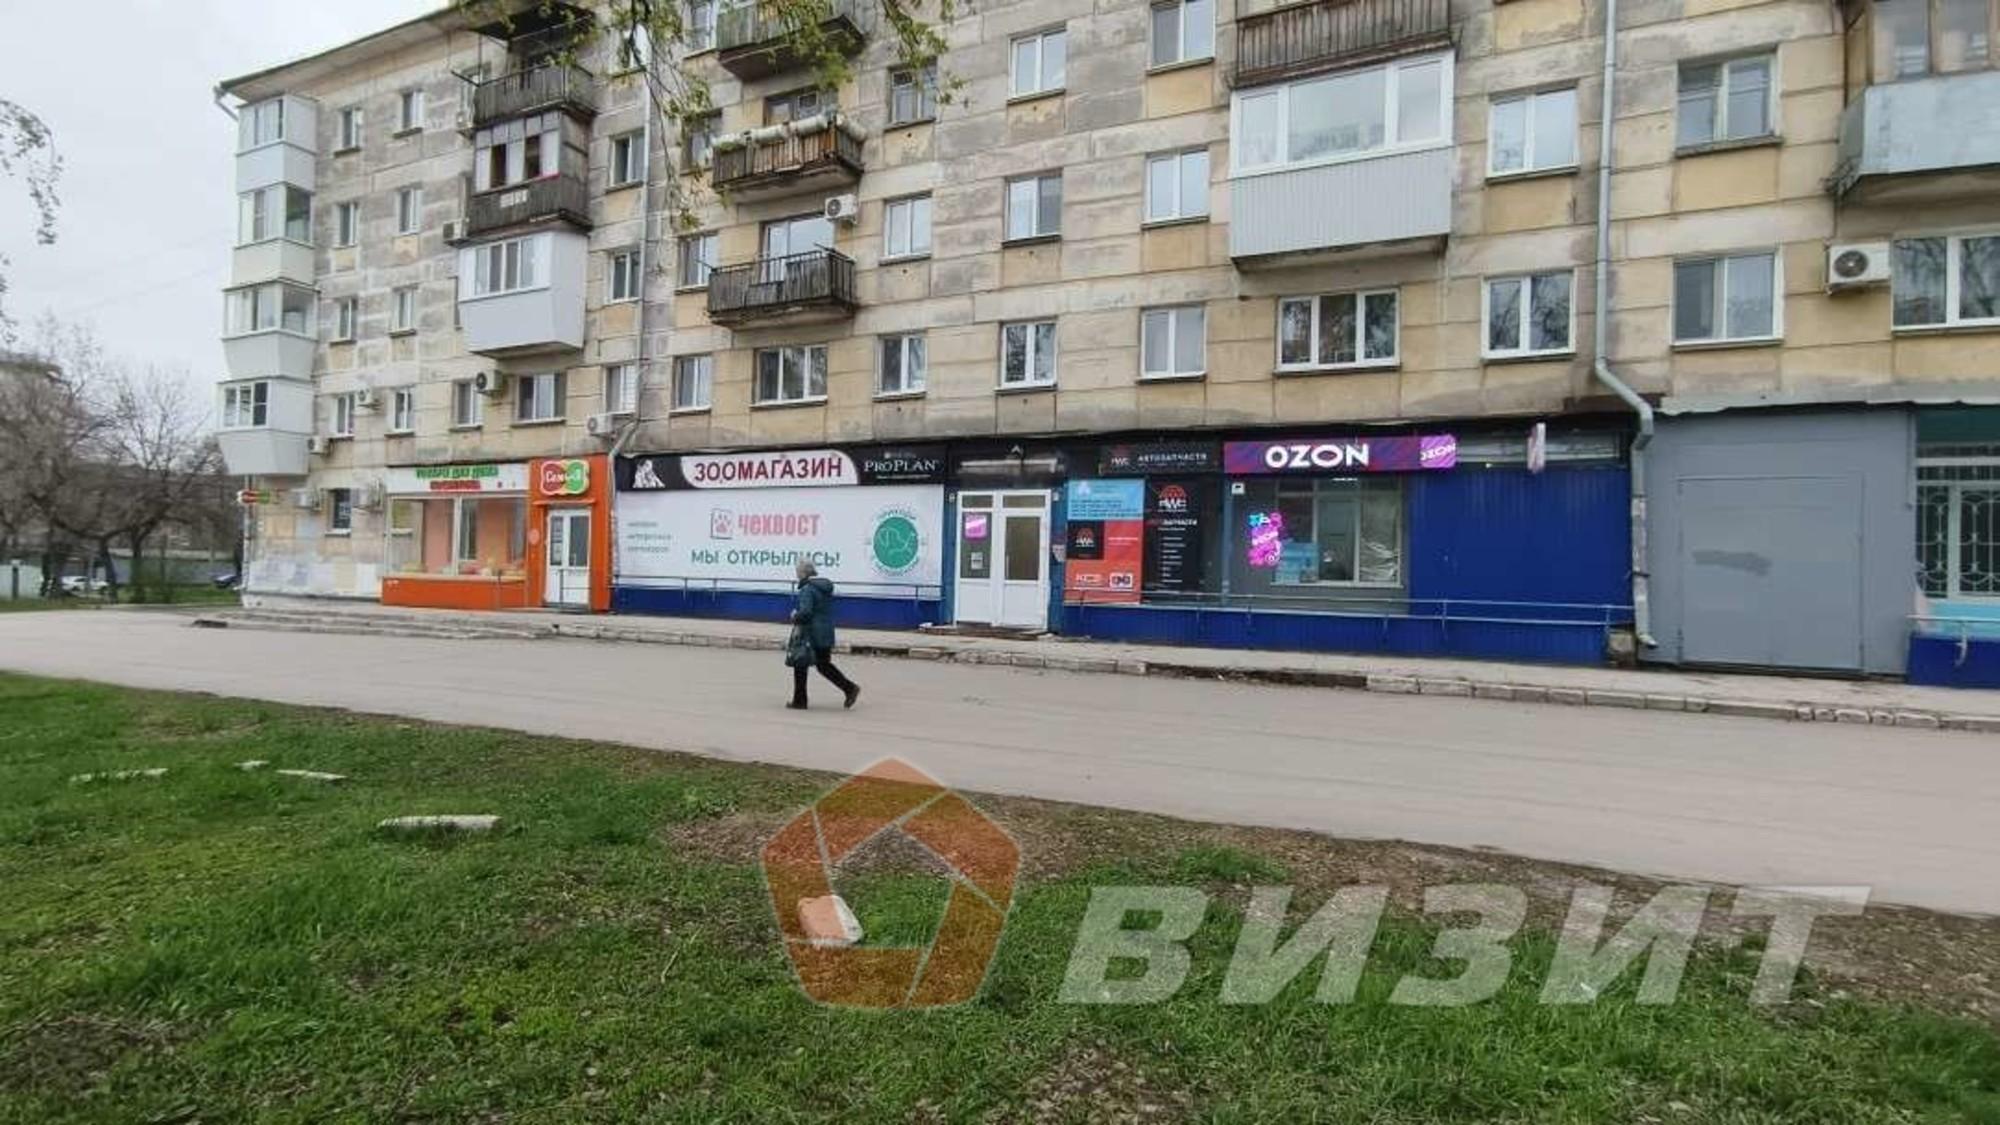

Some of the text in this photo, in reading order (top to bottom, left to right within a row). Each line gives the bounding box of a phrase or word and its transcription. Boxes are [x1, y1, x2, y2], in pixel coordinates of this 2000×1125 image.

[1265, 444, 1369, 468] OZON
[694, 457, 842, 482] ЗООМАГАЗИН
[691, 549, 719, 564] МЫ
